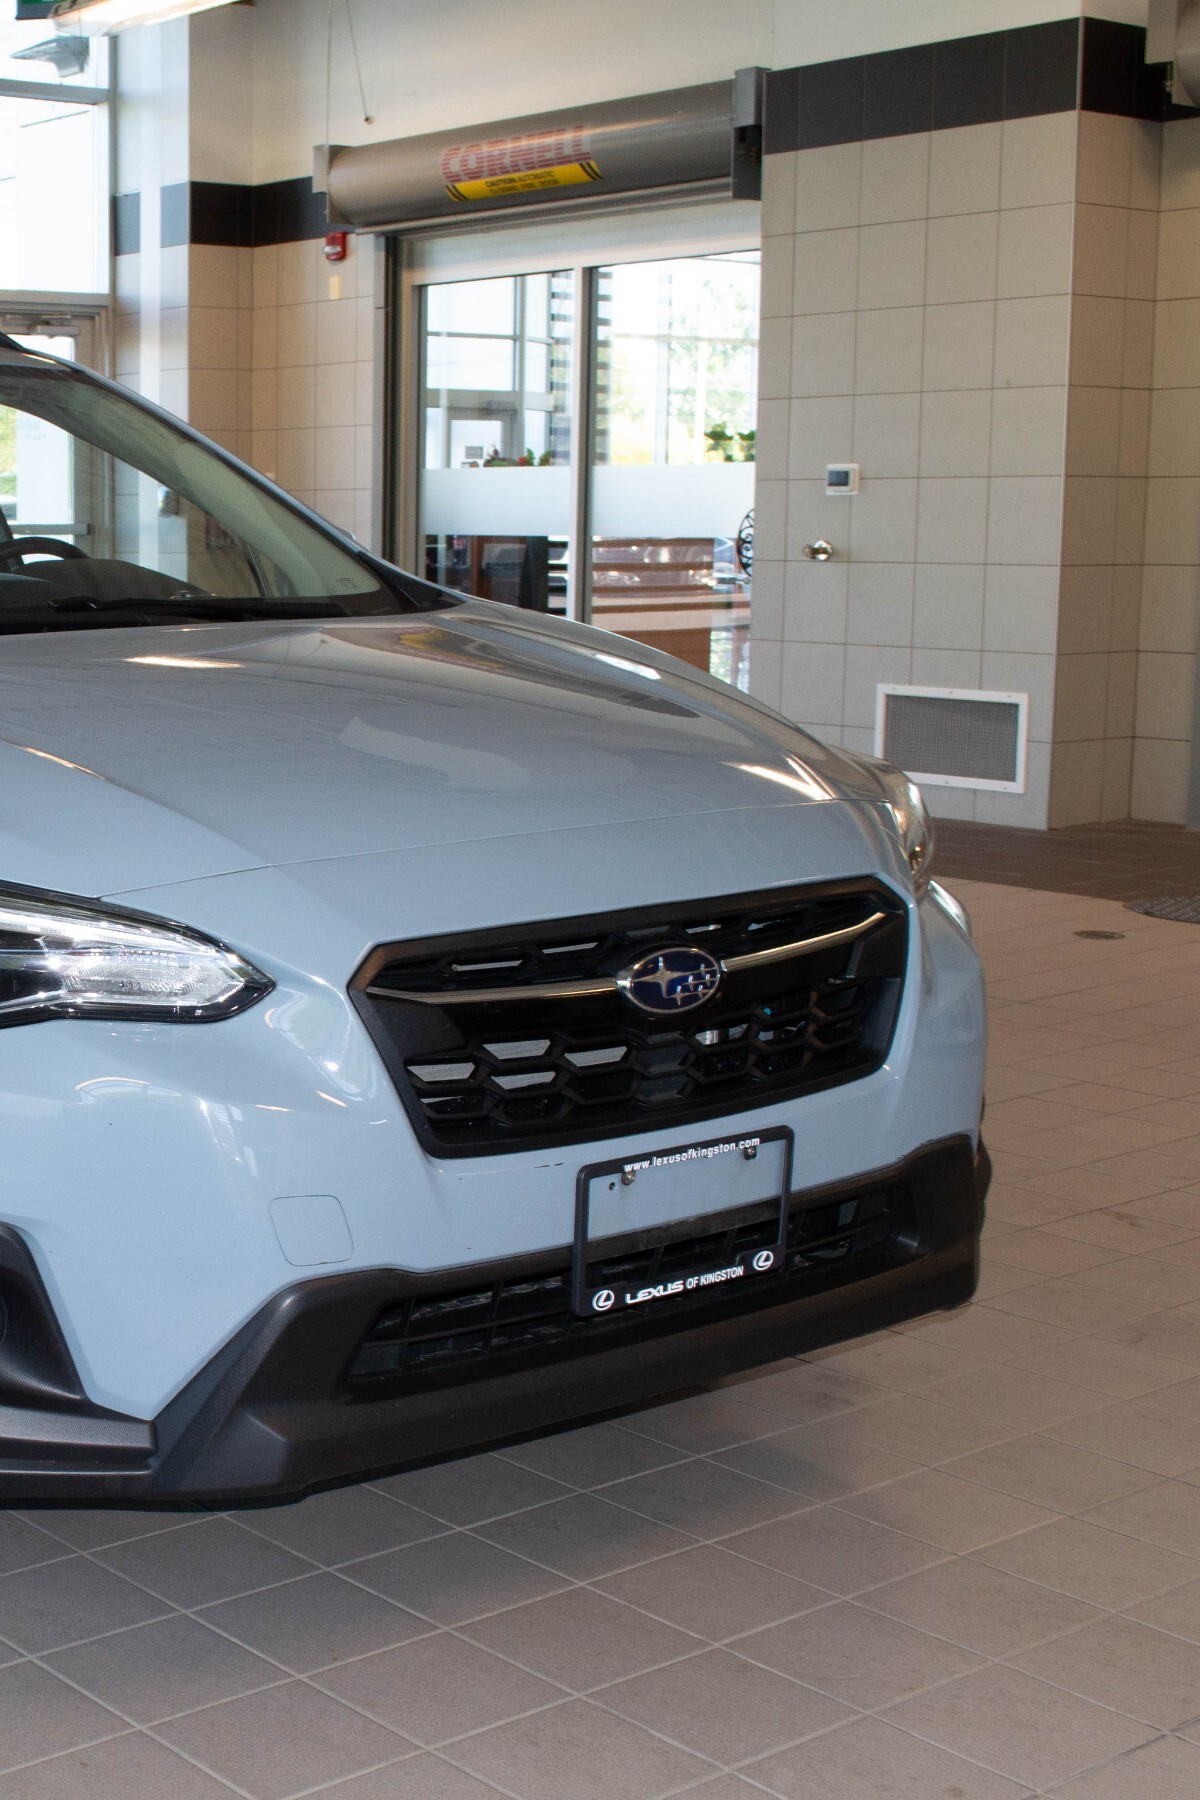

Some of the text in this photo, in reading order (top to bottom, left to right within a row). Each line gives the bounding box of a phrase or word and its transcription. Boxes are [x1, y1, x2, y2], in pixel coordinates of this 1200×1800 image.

[441, 124, 592, 184] CORNELL
[623, 1137, 760, 1173] www.lexusofkingston.com
[625, 1265, 745, 1304] LEXUS OF KINGSTON
